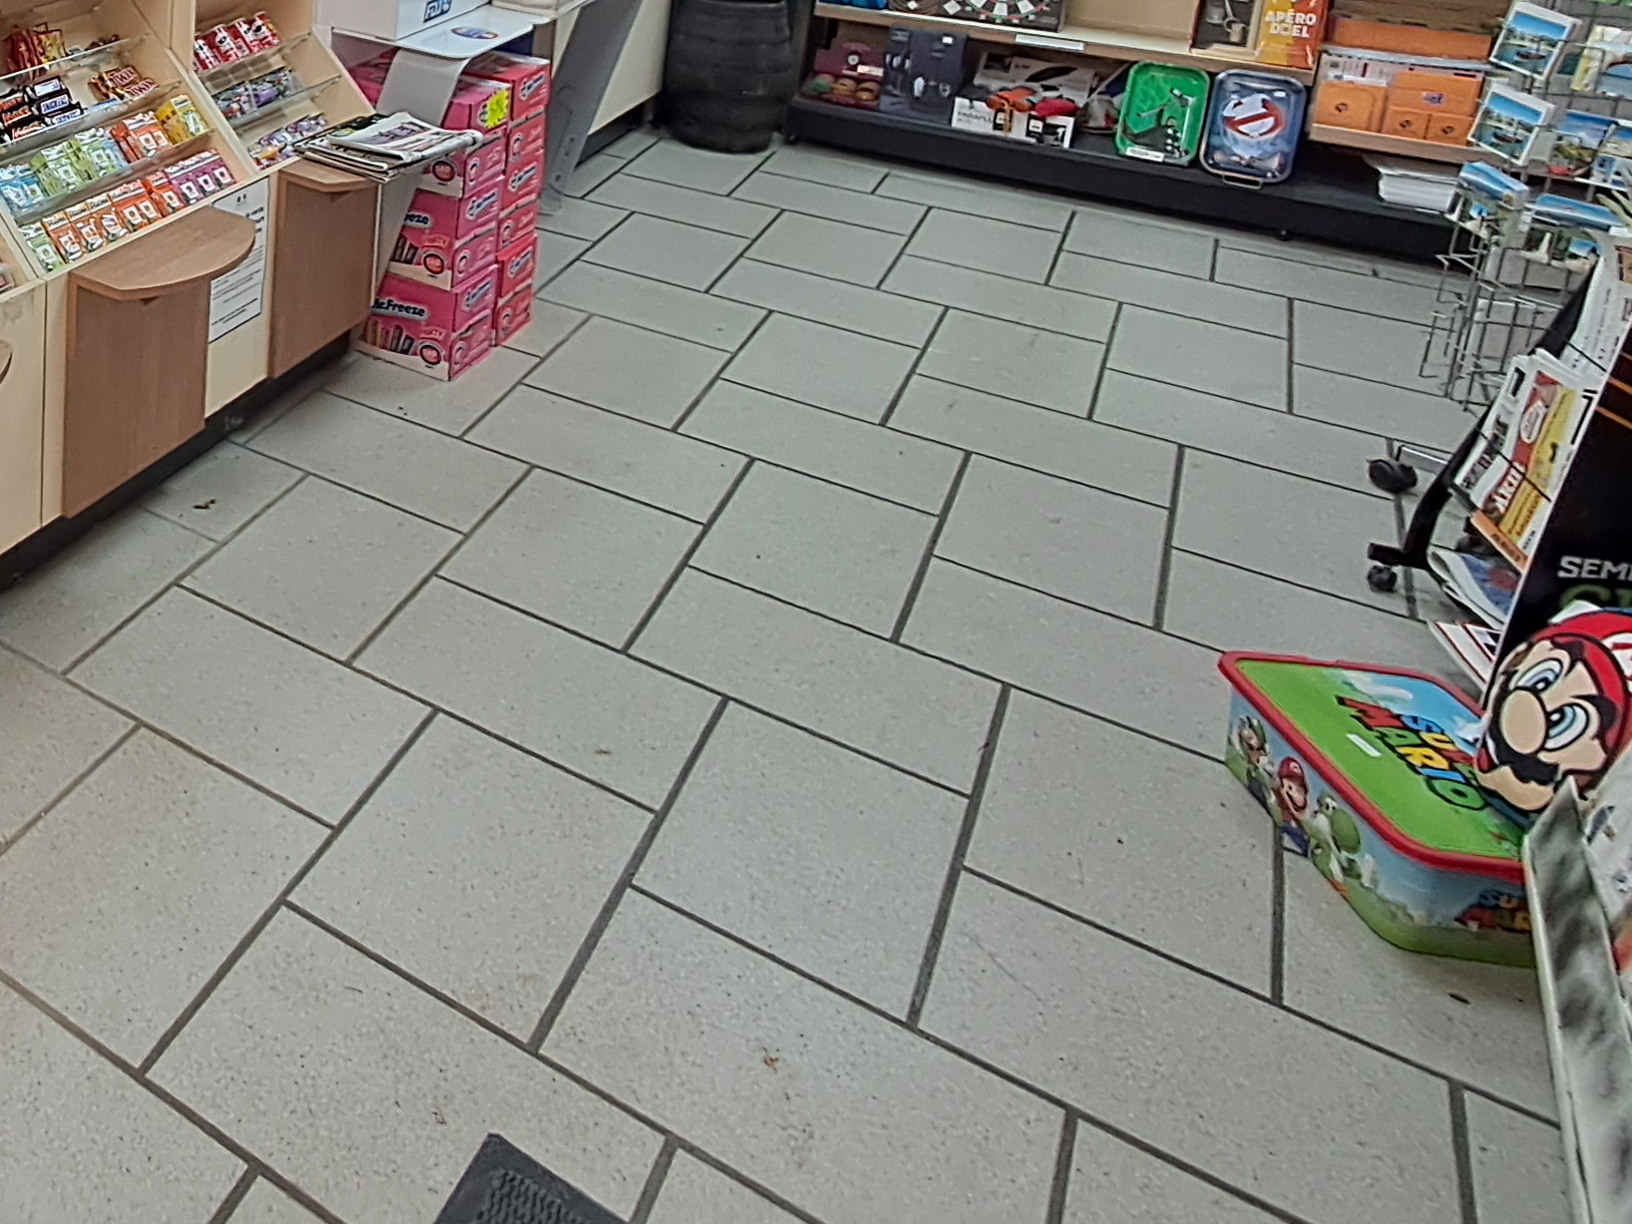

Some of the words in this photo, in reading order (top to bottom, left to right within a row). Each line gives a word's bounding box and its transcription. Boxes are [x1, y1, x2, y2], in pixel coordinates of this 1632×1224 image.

[1266, 8, 1317, 26] APÉRO
[112, 67, 138, 86] TWIX
[128, 79, 155, 97] TWIX
[1557, 556, 1632, 581] SEM
[1335, 694, 1488, 812] MARIO
